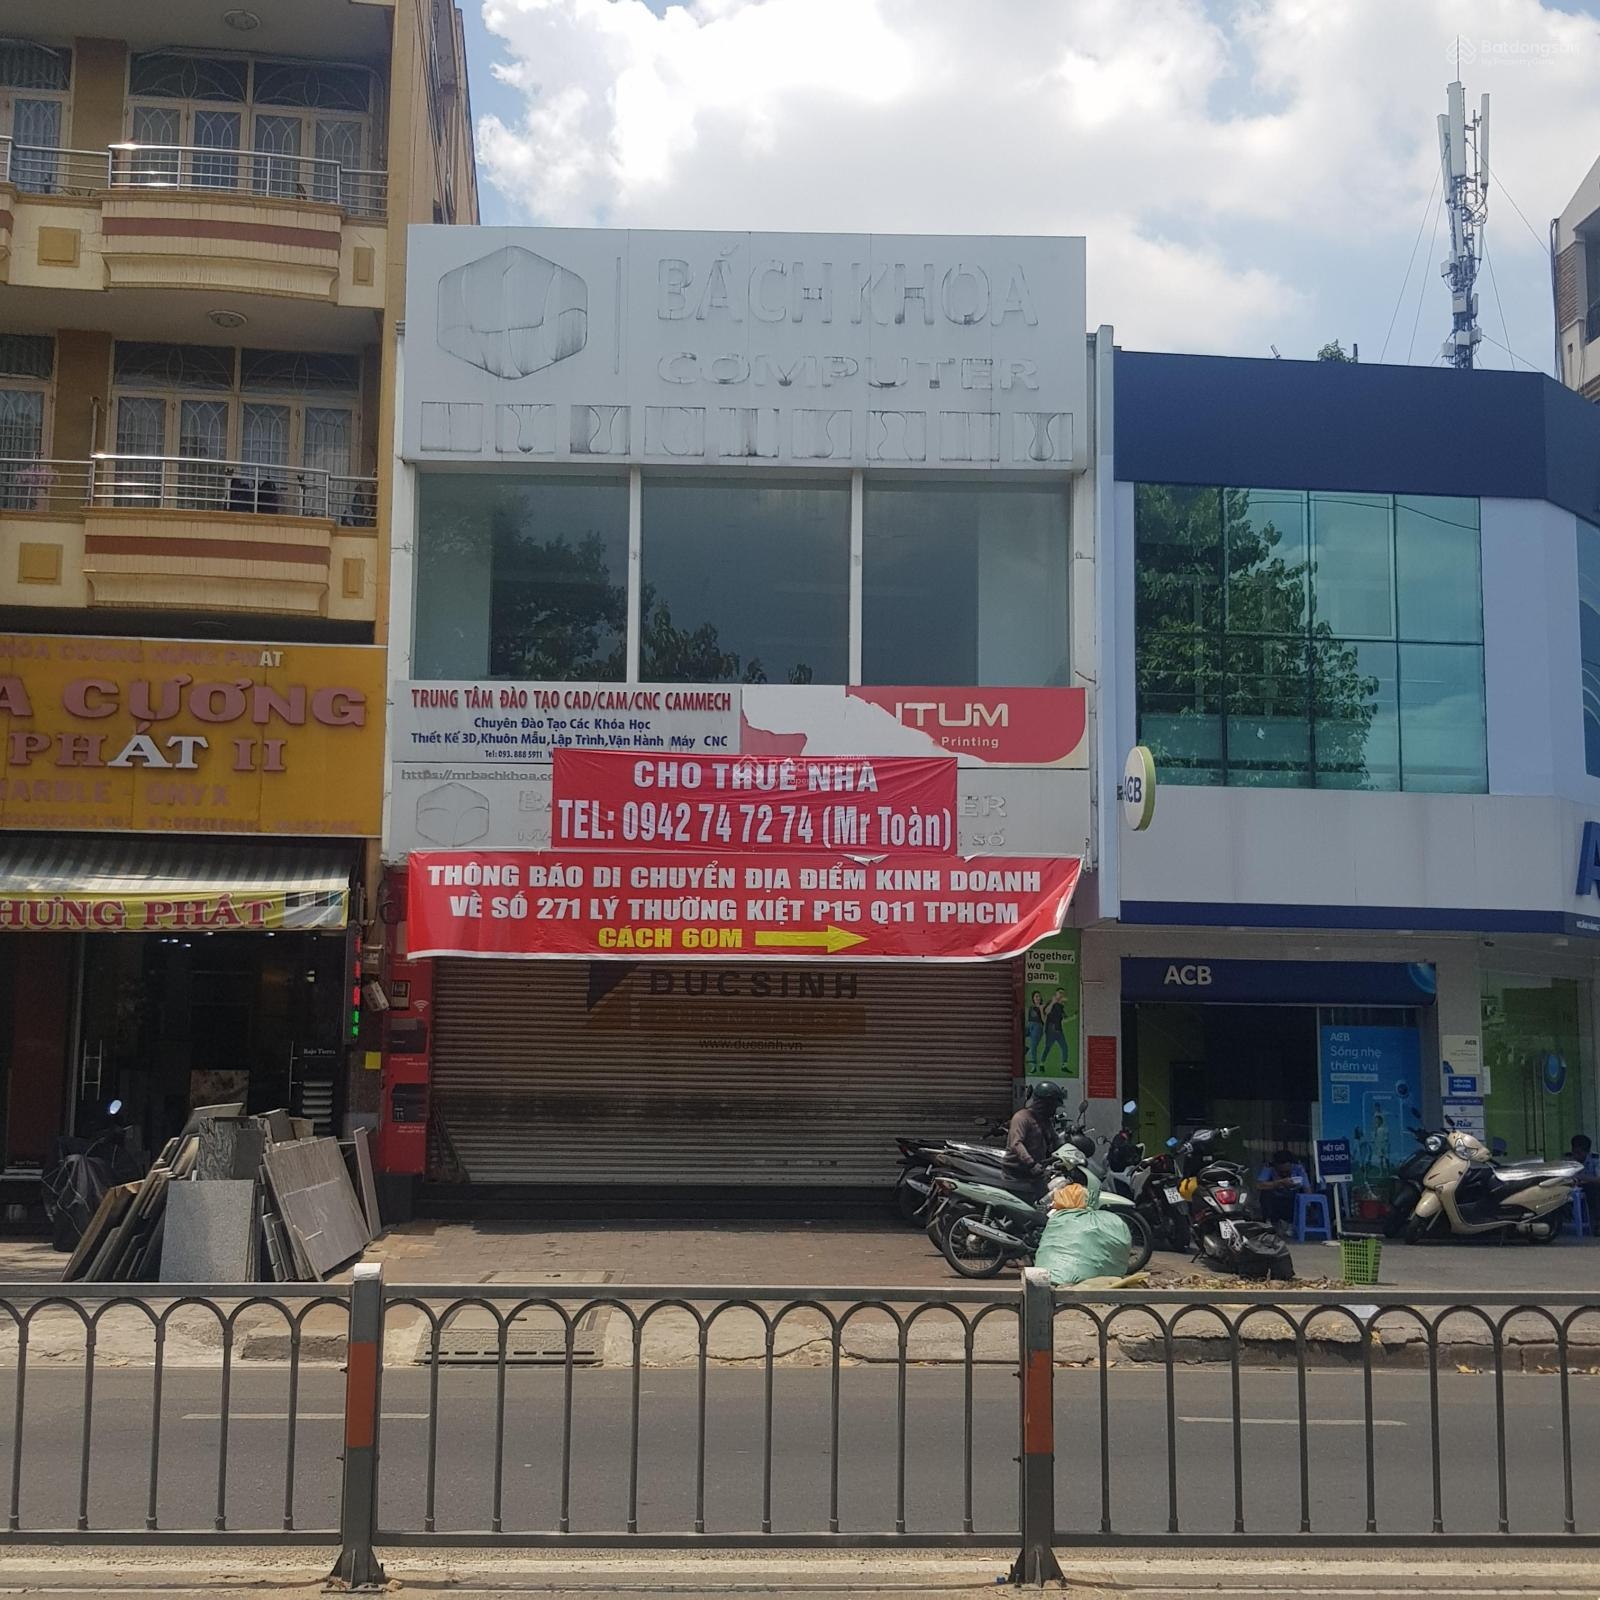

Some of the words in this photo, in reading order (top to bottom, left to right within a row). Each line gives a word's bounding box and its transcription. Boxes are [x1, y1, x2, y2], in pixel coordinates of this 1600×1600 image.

[657, 243, 832, 324] BÁCH
[851, 261, 1039, 328] KHOA
[657, 353, 1040, 392] COMPUTER
[63, 674, 367, 727] CƯƠNG
[411, 688, 458, 709] TRUNG
[464, 686, 493, 709] TÂM
[500, 686, 527, 709] ĐÀO
[534, 690, 560, 714] TẠO
[564, 690, 660, 711] CAD/CAM/CNC
[665, 692, 731, 711] CAMMECH
[474, 717, 517, 731] Chuyên
[521, 717, 544, 729] Đào
[547, 718, 566, 732] Tạo
[570, 718, 590, 730] Các
[594, 718, 625, 730] Khóa
[629, 719, 650, 733] Học
[9, 721, 208, 768] PHÁT
[233, 739, 287, 772] II
[411, 732, 441, 744] Thiết
[444, 730, 461, 744] Kế
[634, 734, 664, 746] Hành
[671, 735, 695, 749] Máy
[703, 736, 728, 746] CNC
[941, 736, 1000, 750] Printing
[634, 761, 702, 788] CHO
[712, 757, 797, 790] THUÊ
[808, 761, 878, 792] NHÀ
[558, 799, 615, 840] TEL:
[622, 801, 691, 842] 0942
[699, 803, 732, 843] 74
[741, 804, 772, 844] 72
[781, 805, 813, 844] 74
[822, 805, 870, 848] (Mr
[878, 806, 952, 851] Toàn)
[427, 861, 520, 887] THÔNG
[529, 862, 584, 888] BÁO
[593, 867, 621, 888] DI
[630, 860, 736, 889] CHUYỂN
[745, 867, 791, 893] ĐỊA
[800, 861, 866, 891] ĐIỂM
[875, 870, 941, 892] KINH
[950, 870, 1041, 893] DOANH
[143, 892, 273, 927] PHÁT
[449, 890, 483, 918] VỀ
[491, 890, 528, 919] SỐ
[537, 898, 581, 919] 271
[590, 893, 621, 920] LÝ
[628, 894, 737, 921] THƯỜNG
[747, 897, 805, 925] KIỆT
[813, 900, 861, 922] P15
[871, 901, 915, 926] Q11
[923, 902, 1019, 924] TPHCM
[598, 924, 672, 948] CÁCH
[681, 927, 742, 949] 60M
[1027, 950, 1074, 962] Together,
[1027, 962, 1041, 970] we
[1163, 965, 1212, 986] ACB
[1330, 1032, 1350, 1042] ACB
[1330, 1046, 1358, 1059] Sống
